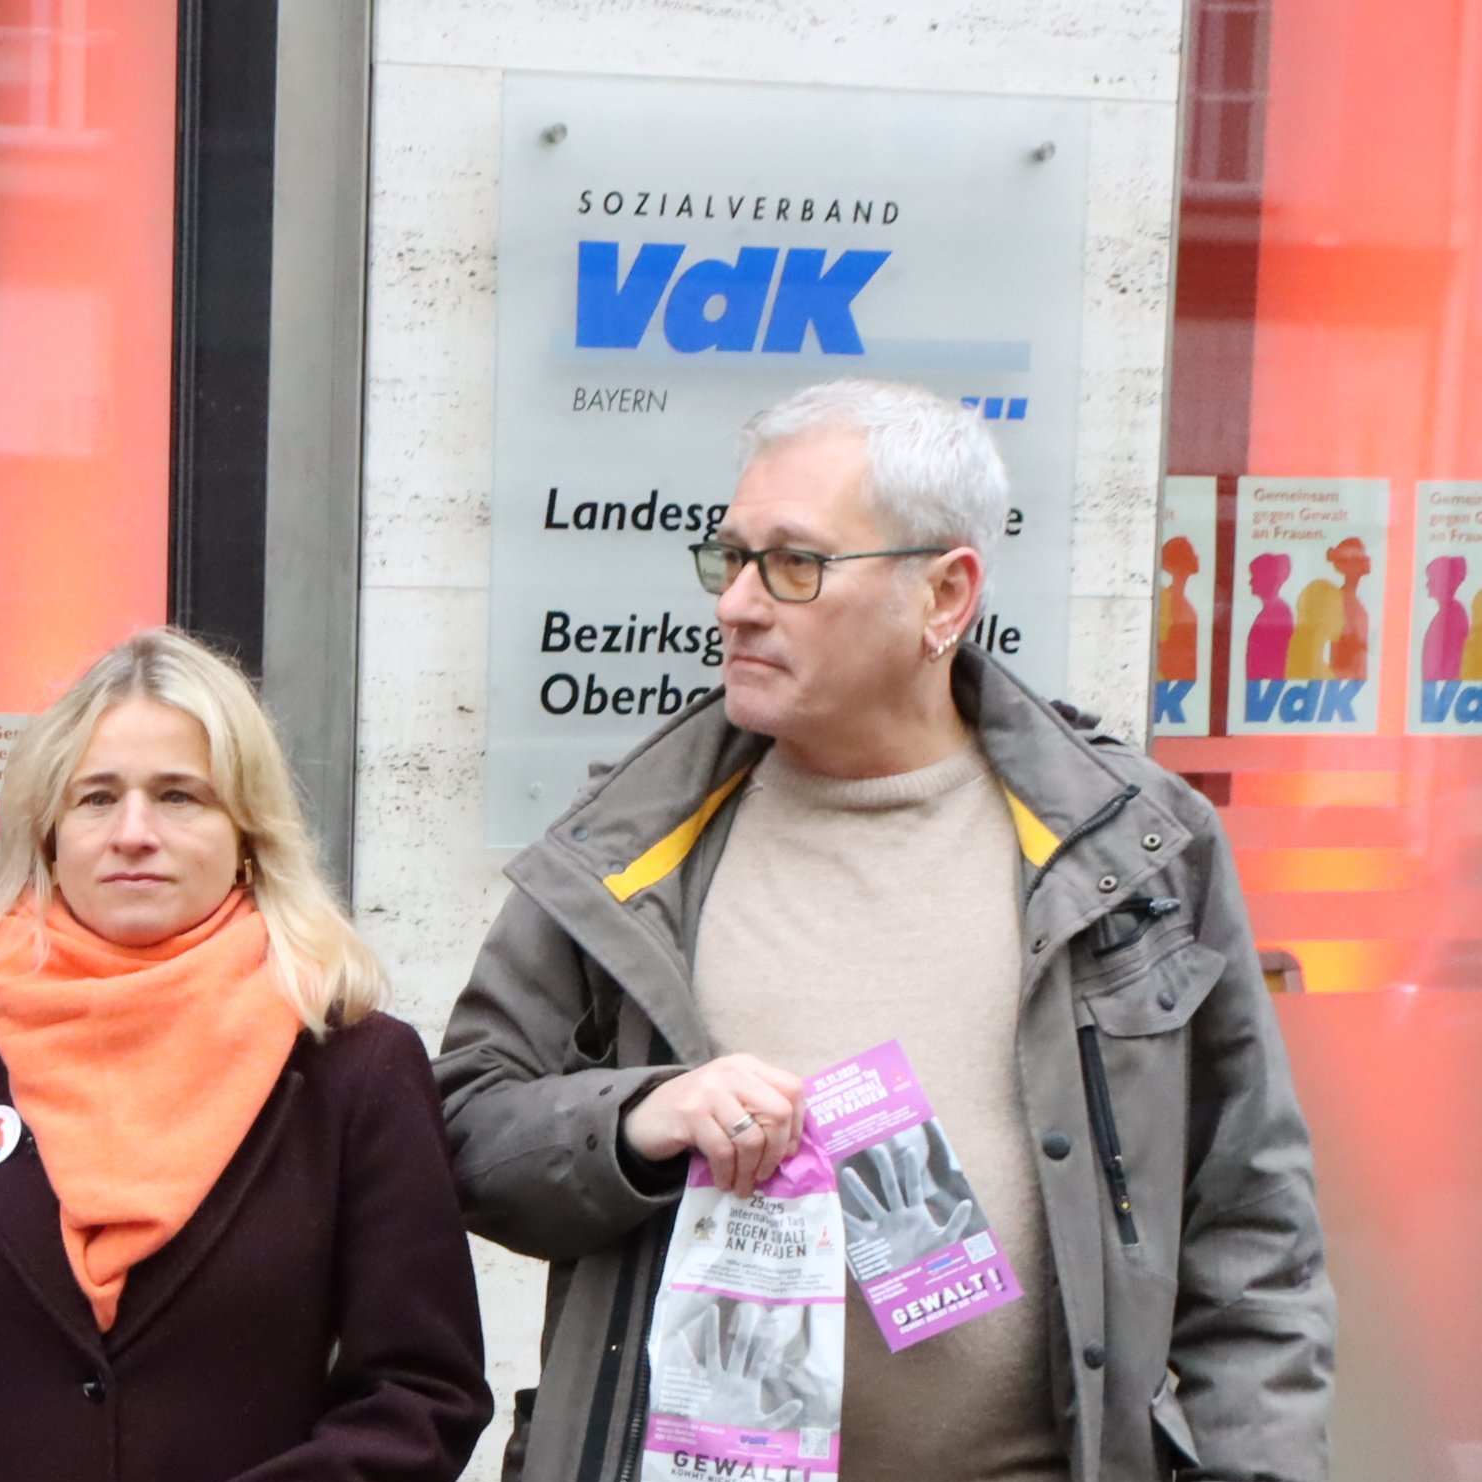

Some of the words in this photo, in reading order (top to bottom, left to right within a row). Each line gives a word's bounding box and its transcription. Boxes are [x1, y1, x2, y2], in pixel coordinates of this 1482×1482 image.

[578, 190, 901, 225] SOZIALVERBAND
[575, 240, 893, 356] VdK
[573, 387, 668, 414] BAYERN
[1253, 488, 1340, 503] Gemeinsam
[1253, 510, 1295, 525] gegen
[1299, 508, 1349, 522] Gewalt
[1429, 512, 1471, 526] gegen
[1251, 527, 1269, 540] an
[1244, 680, 1367, 723] VdK
[727, 1221, 768, 1240] GEGEN
[725, 1238, 746, 1251] AN
[671, 1468, 704, 1480] KOMMT
